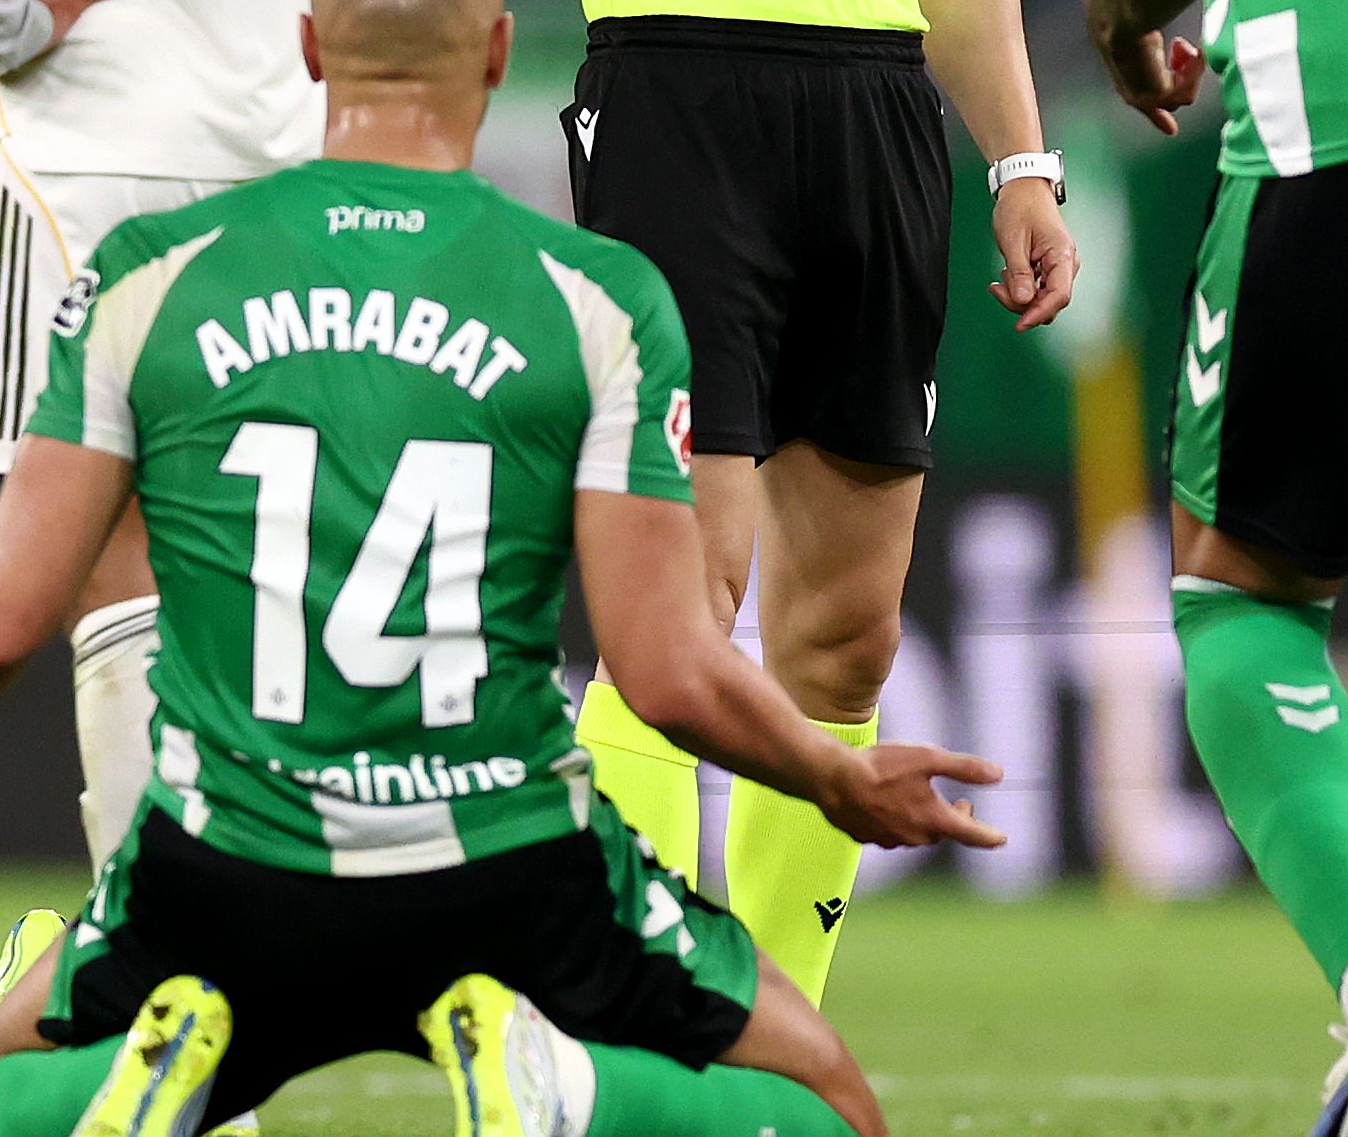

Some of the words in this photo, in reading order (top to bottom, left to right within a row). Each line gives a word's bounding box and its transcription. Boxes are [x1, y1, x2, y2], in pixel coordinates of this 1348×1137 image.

[324, 205, 425, 235] prima
[194, 287, 528, 400] AMRABAT
[217, 420, 494, 729] 14
[267, 750, 527, 803] ainline
